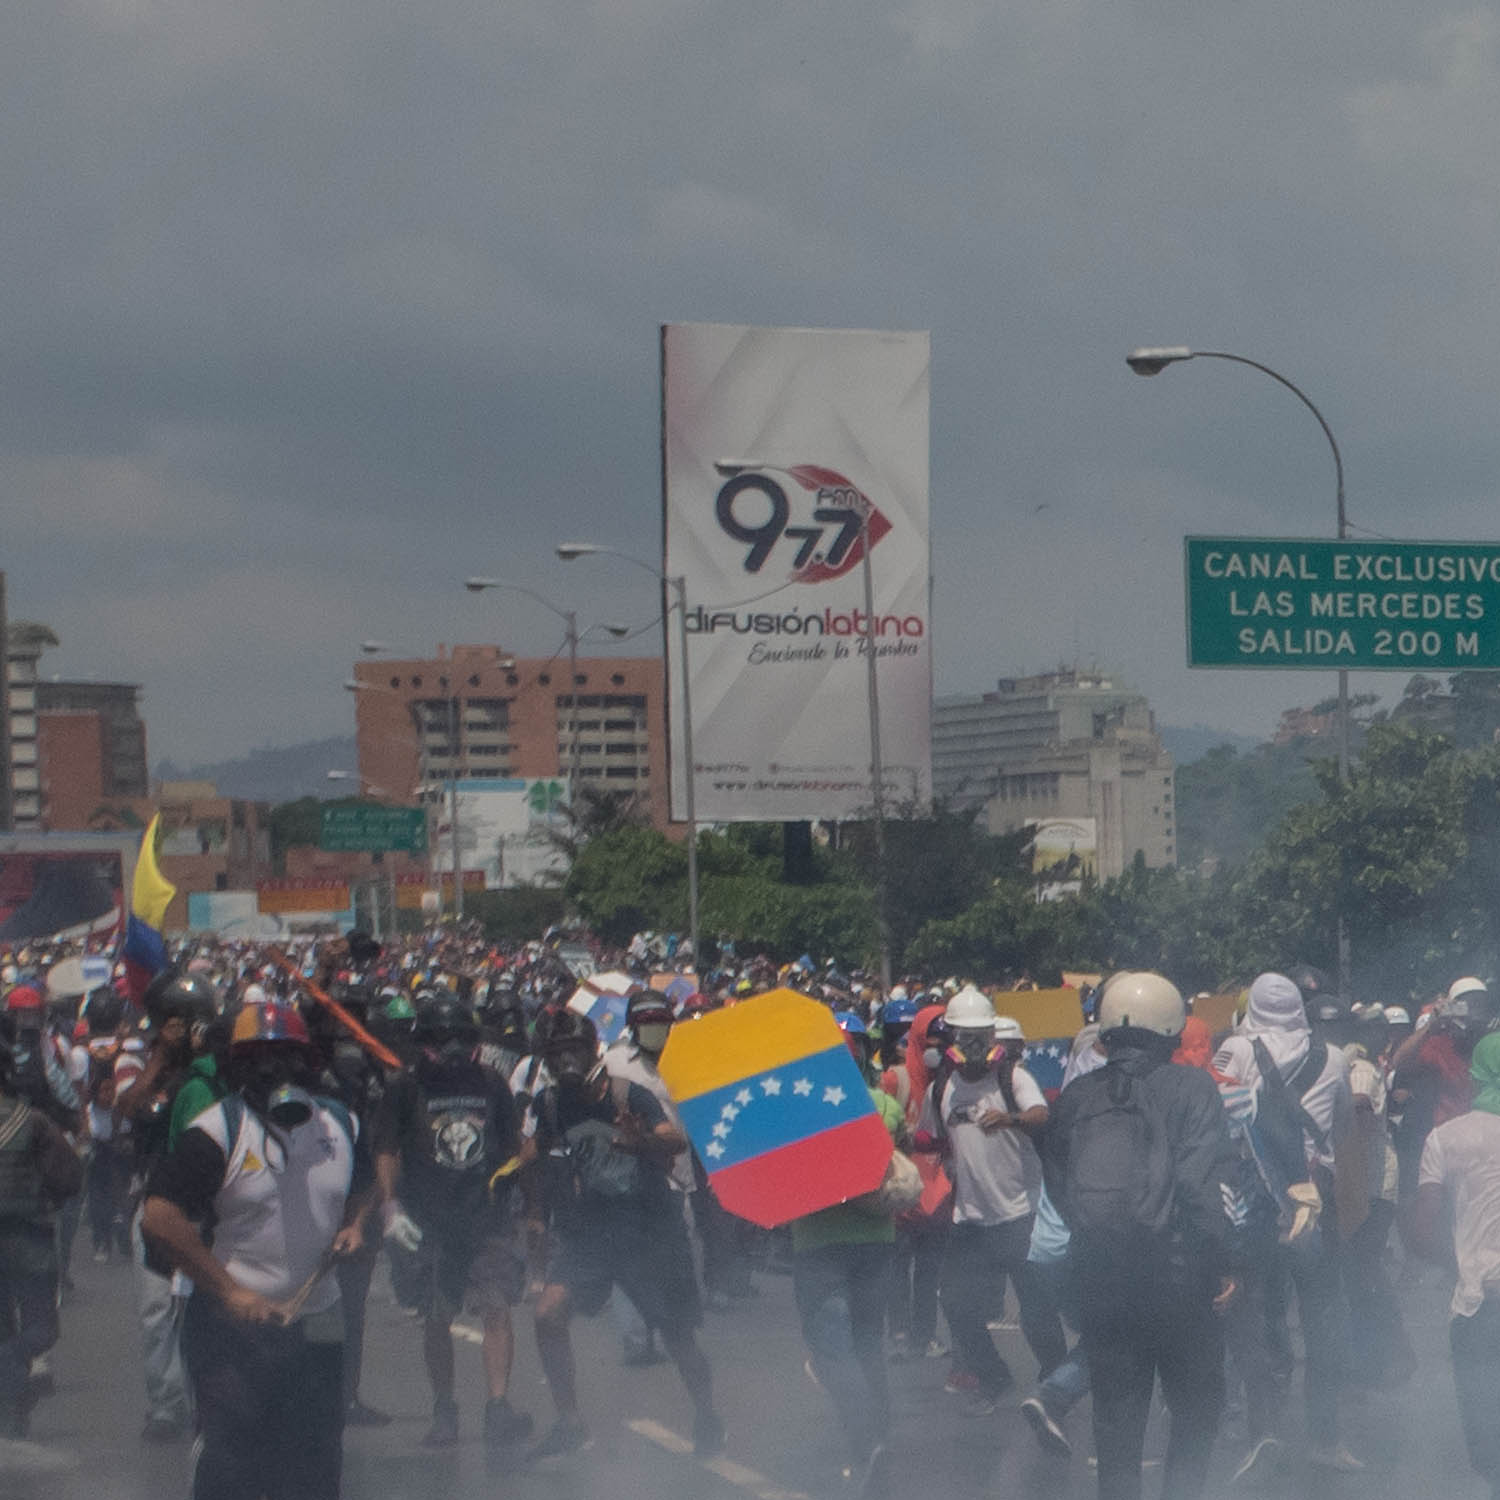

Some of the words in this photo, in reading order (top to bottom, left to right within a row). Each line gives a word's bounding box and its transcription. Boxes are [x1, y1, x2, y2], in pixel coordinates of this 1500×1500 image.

[716, 473, 863, 574] 97.7
[1203, 552, 1318, 580] CANAL
[1229, 591, 1295, 617] LAS
[1310, 592, 1485, 619] MERCEDES
[1238, 628, 1356, 655] SALIDA
[1374, 630, 1442, 656] 200
[1456, 631, 1479, 656] M
